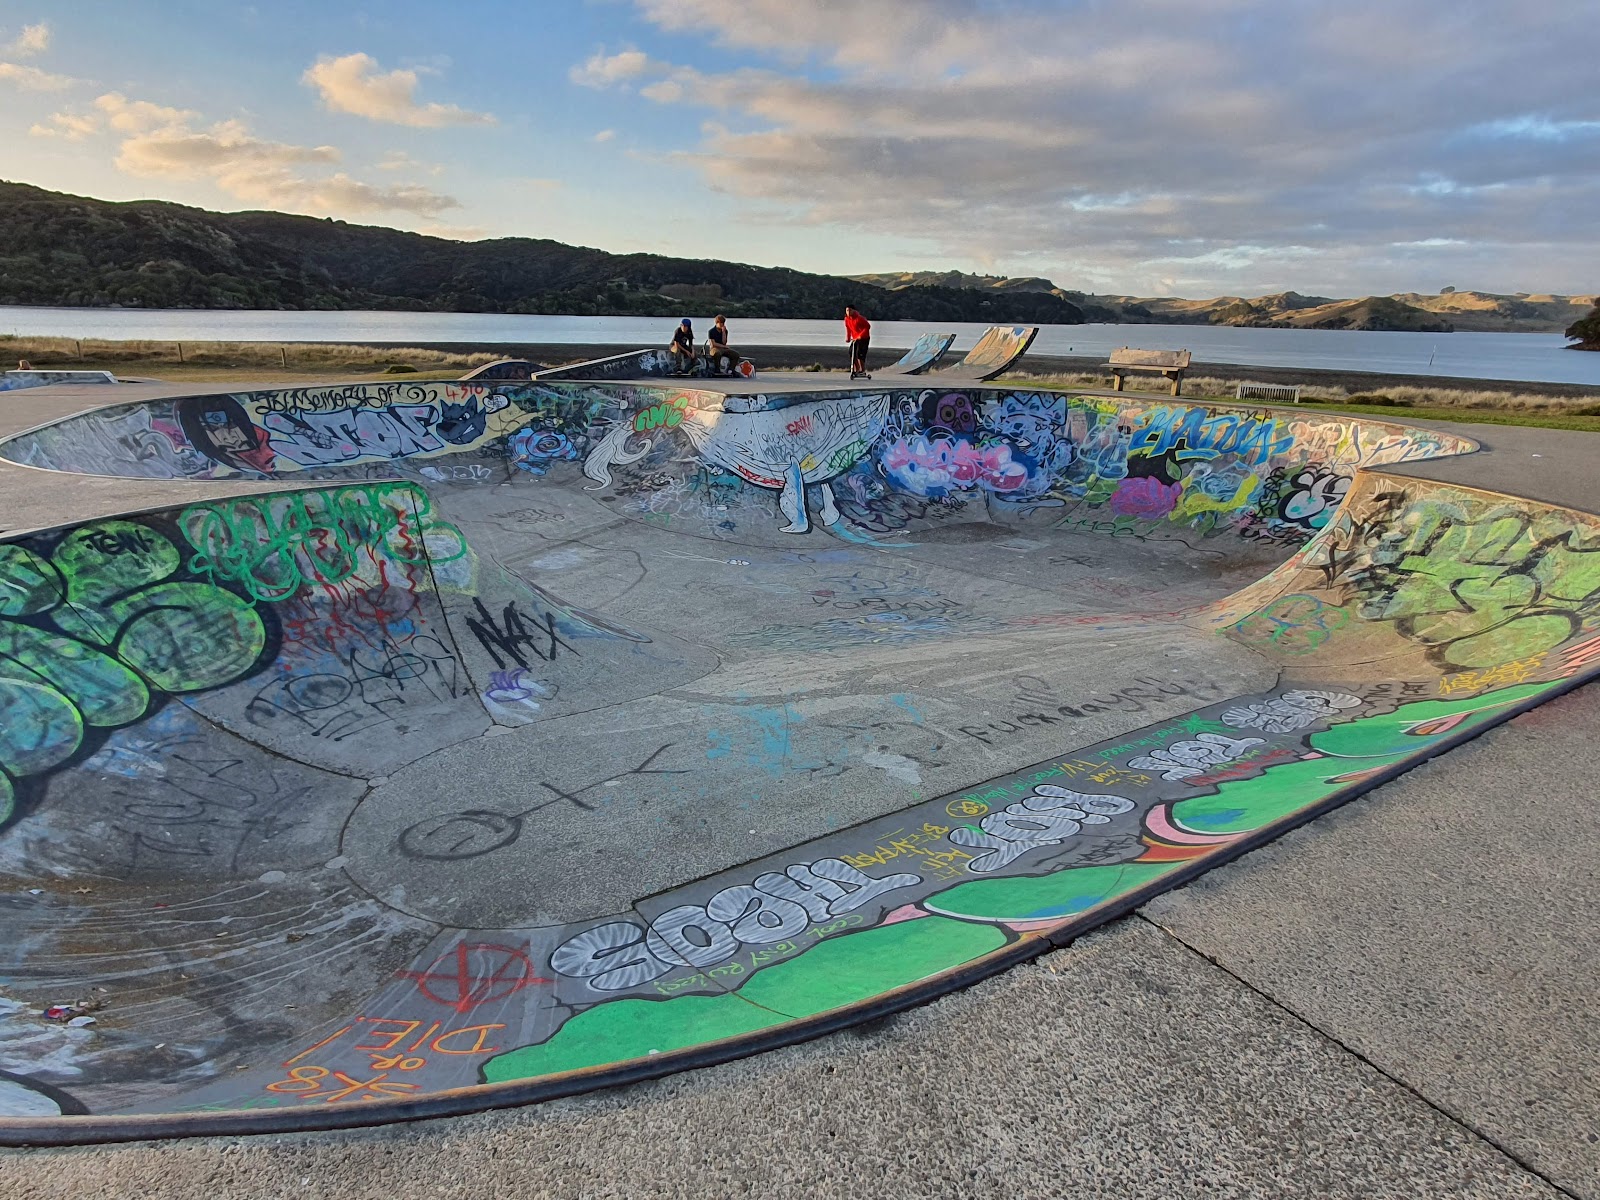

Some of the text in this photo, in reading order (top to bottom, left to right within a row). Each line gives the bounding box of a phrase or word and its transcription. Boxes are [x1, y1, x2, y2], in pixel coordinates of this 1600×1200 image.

[281, 1014, 507, 1068] DIE!
[370, 1052, 427, 1071] OR
[266, 1064, 422, 1102] SK8
